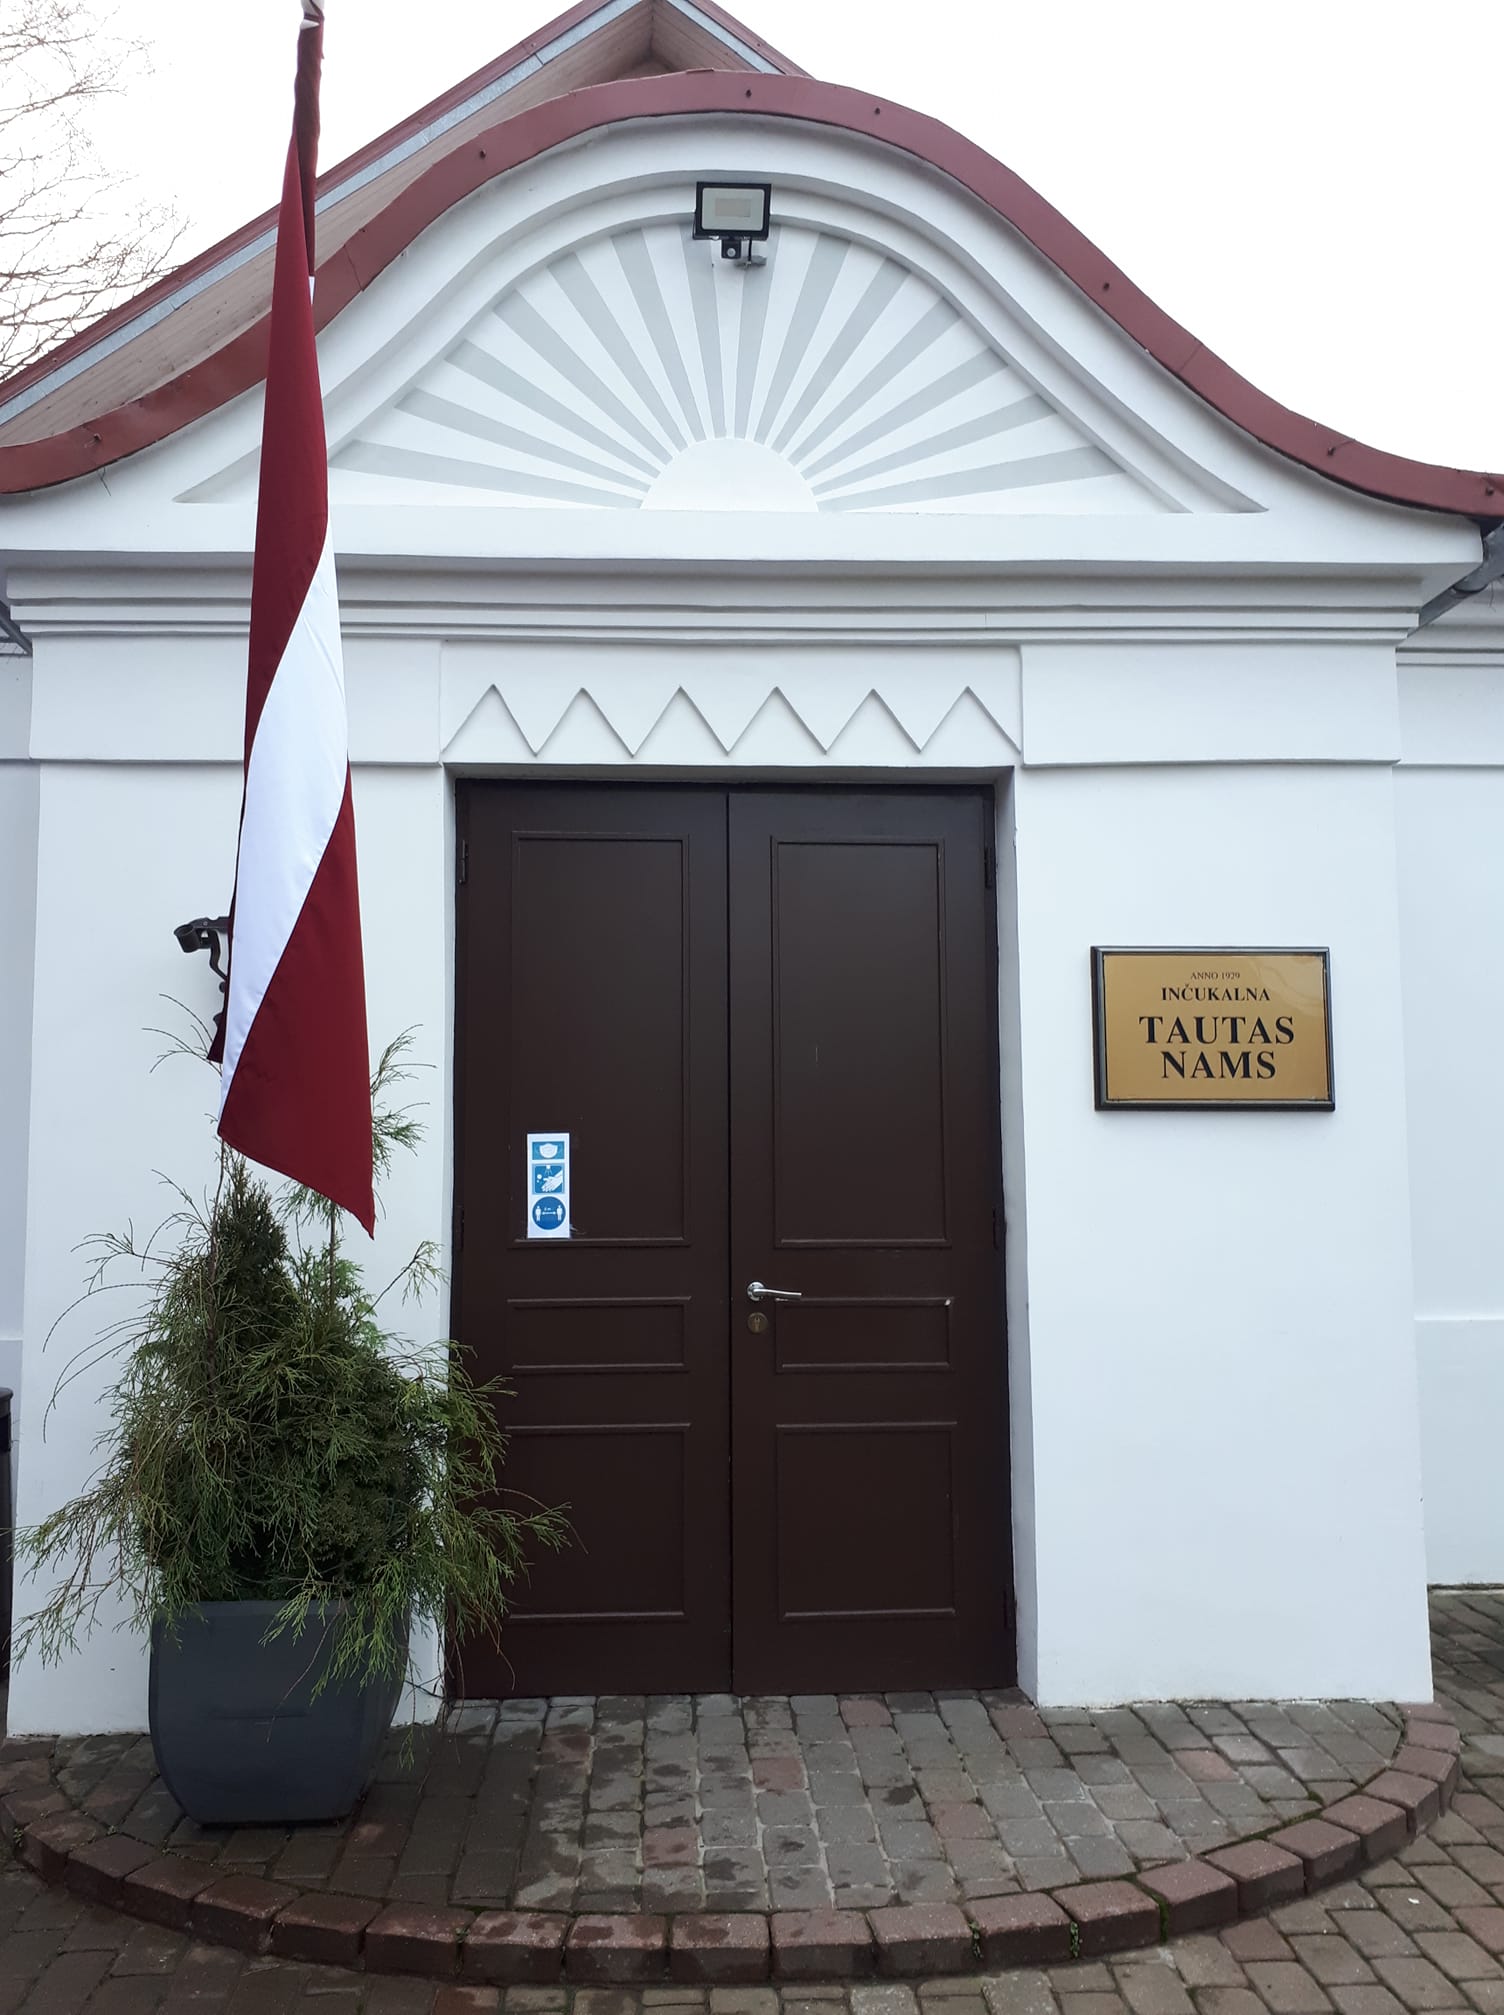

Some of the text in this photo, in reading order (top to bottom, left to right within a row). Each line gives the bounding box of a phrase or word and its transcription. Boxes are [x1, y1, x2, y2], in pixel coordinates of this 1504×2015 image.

[1190, 971, 1241, 980] ANNO 1929
[1161, 983, 1271, 1001] INČUKALNA
[1138, 1016, 1295, 1045] TAUTAS
[1161, 1050, 1277, 1079] NAMS
